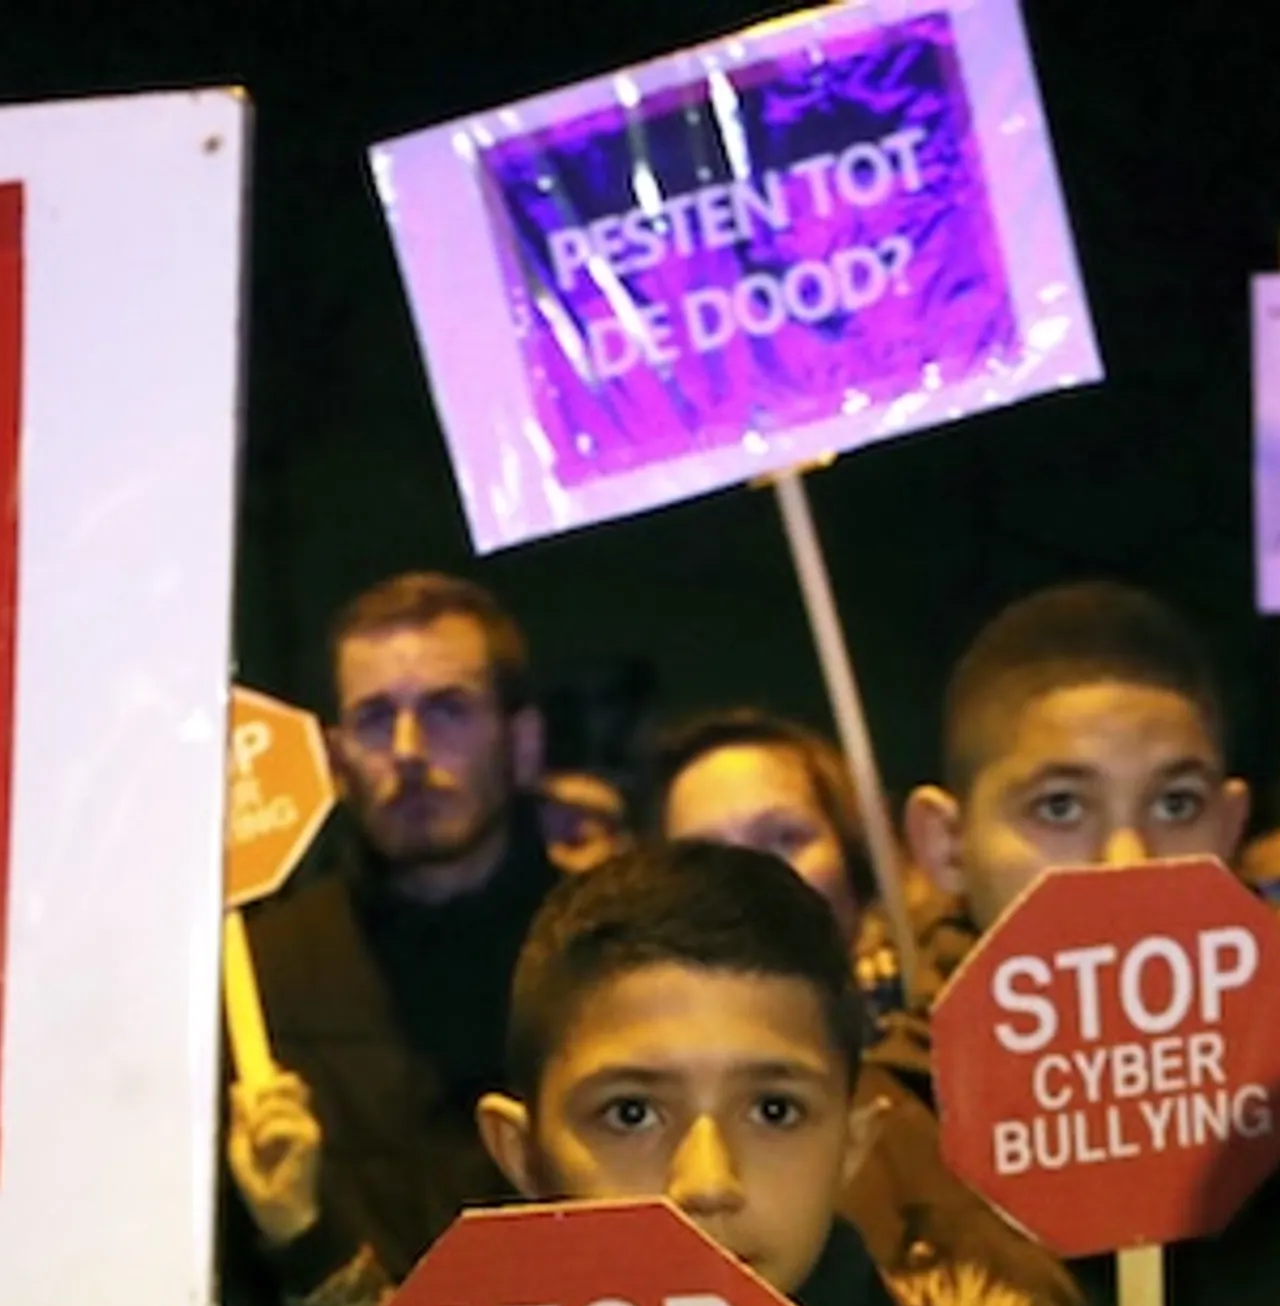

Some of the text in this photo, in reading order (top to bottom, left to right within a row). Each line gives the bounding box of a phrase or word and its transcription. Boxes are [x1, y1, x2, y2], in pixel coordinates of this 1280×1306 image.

[550, 129, 929, 291] PESTEN TOT
[684, 237, 912, 353] DOOD?
[991, 926, 1259, 1053] STOP
[1033, 1031, 1226, 1110] CYBER
[993, 1083, 1273, 1175] BULLYING
